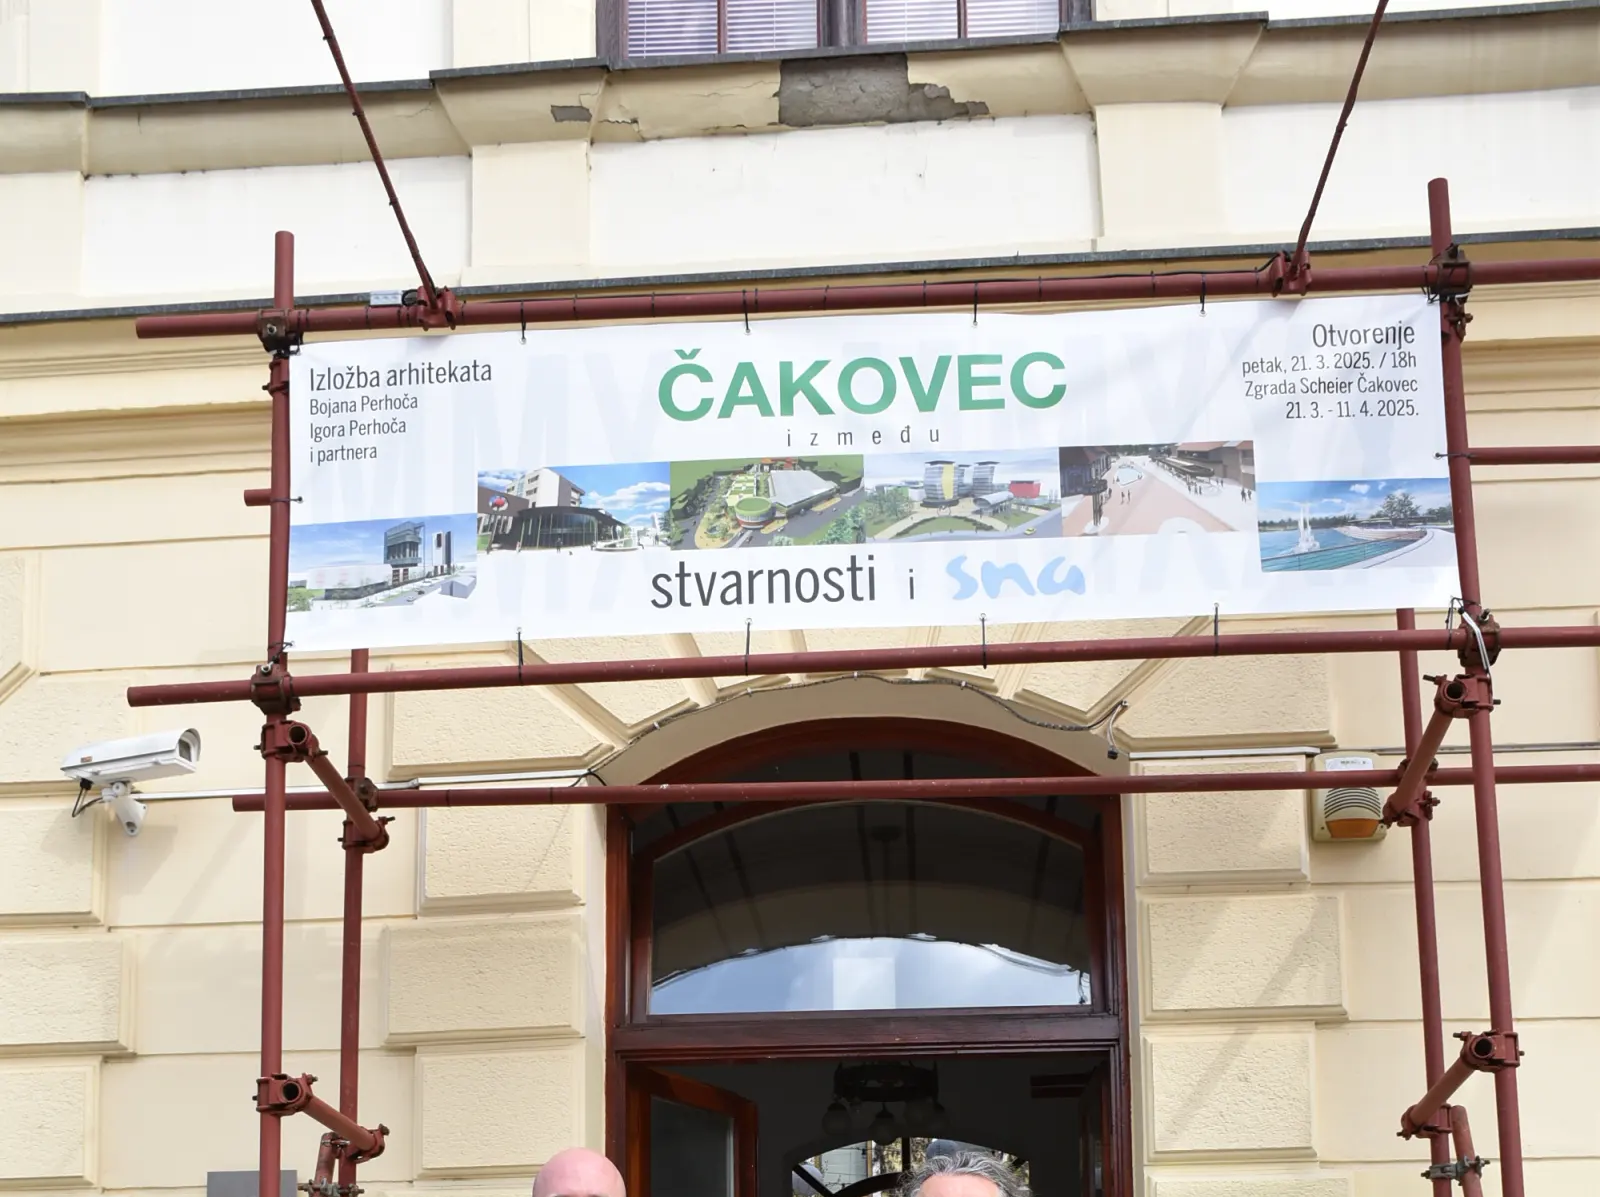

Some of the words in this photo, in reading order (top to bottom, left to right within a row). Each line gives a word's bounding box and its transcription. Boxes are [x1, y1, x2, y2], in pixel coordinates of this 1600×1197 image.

[1312, 320, 1415, 351] Otvorenje
[310, 365, 380, 392] Izložba
[386, 359, 492, 387] arhitekata
[1242, 356, 1287, 378] petak,
[1291, 355, 1311, 372] 21.
[1315, 355, 1330, 371] 3.
[1333, 352, 1375, 370] 2025.
[1379, 352, 1387, 369] /
[1391, 351, 1417, 369] 18h
[659, 348, 1067, 421] ČAKOVEC
[1244, 379, 1296, 400] Zgrada
[1299, 376, 1354, 394] Scheier
[1357, 371, 1418, 394] Čakovec
[310, 398, 357, 419] Bojana
[361, 393, 418, 412] Perhoča
[1285, 401, 1306, 419] 21.
[1310, 401, 1324, 418] 3.
[1337, 400, 1356, 418] 11.
[1359, 400, 1374, 417] 4.
[1378, 399, 1419, 417] 2025.
[310, 422, 345, 443] Igora
[349, 417, 406, 437] Perhoča
[310, 446, 315, 463] i
[317, 445, 377, 467] partnera
[650, 554, 876, 609] stvarnosti
[908, 567, 916, 601] i
